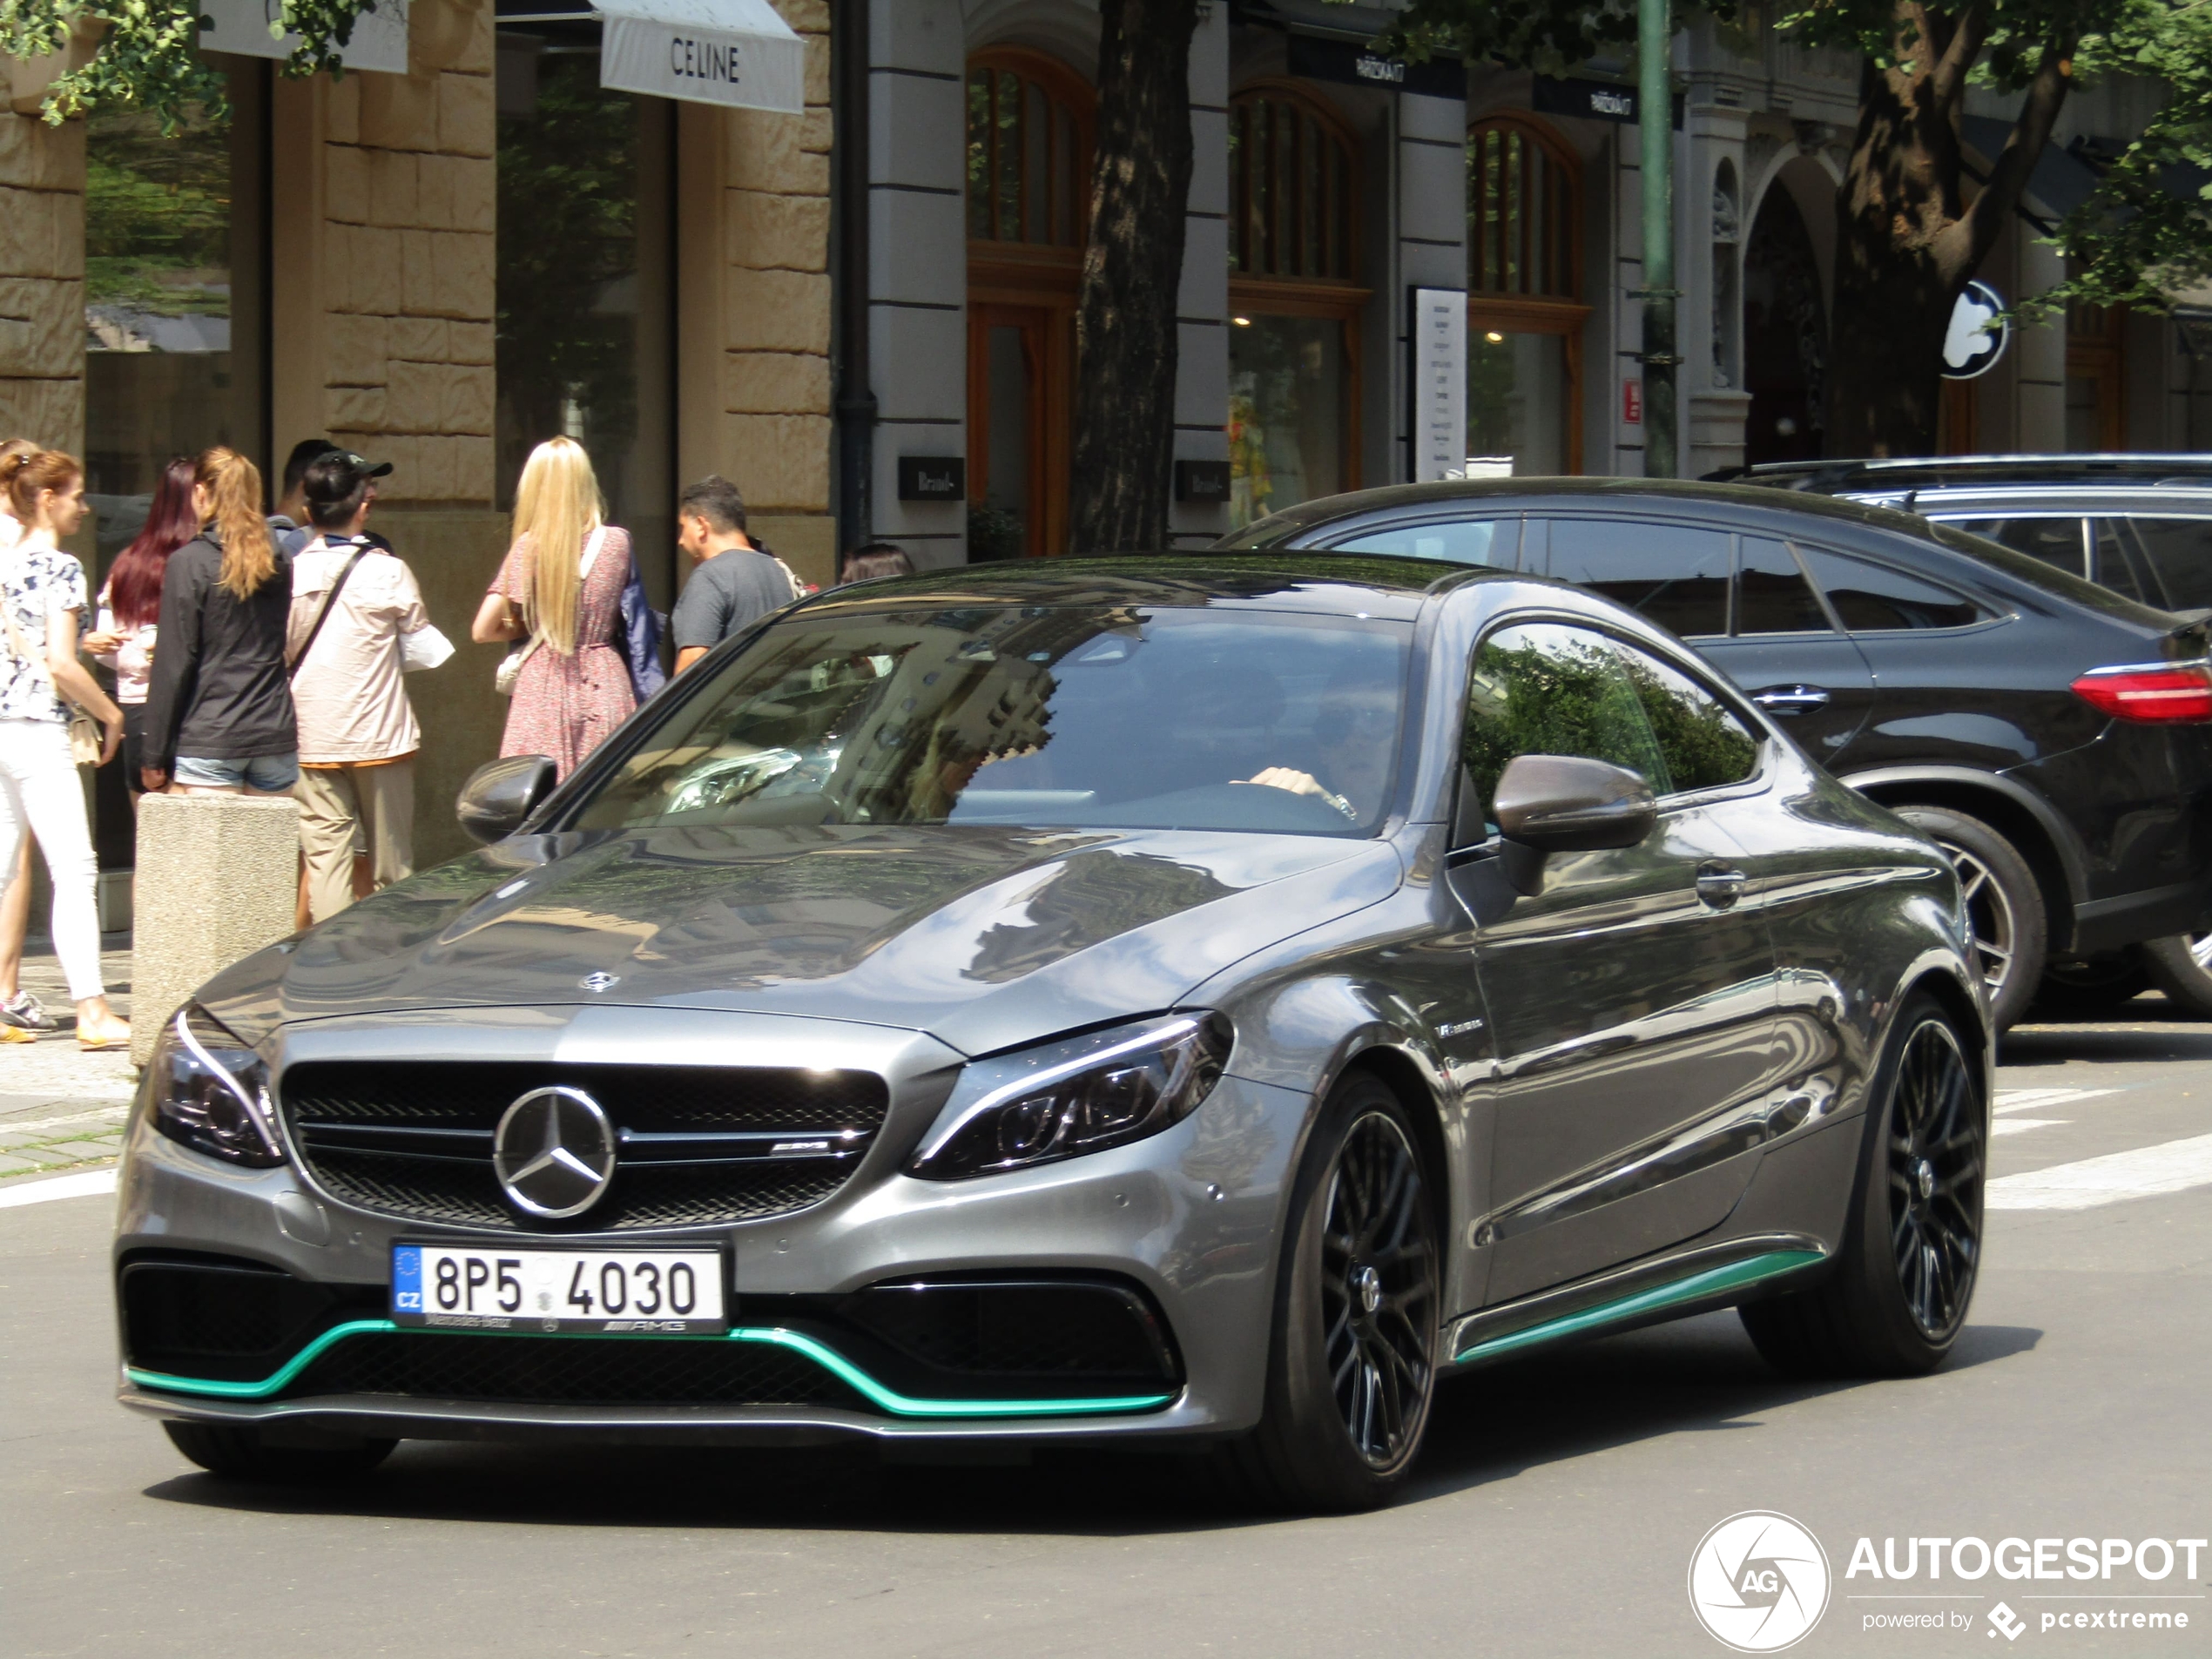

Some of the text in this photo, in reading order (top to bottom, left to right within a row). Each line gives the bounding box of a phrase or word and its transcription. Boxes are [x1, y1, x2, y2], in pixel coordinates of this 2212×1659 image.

[671, 37, 738, 83] CELINE
[397, 1292, 421, 1308] CZ
[436, 1257, 696, 1315] 8P5 4030
